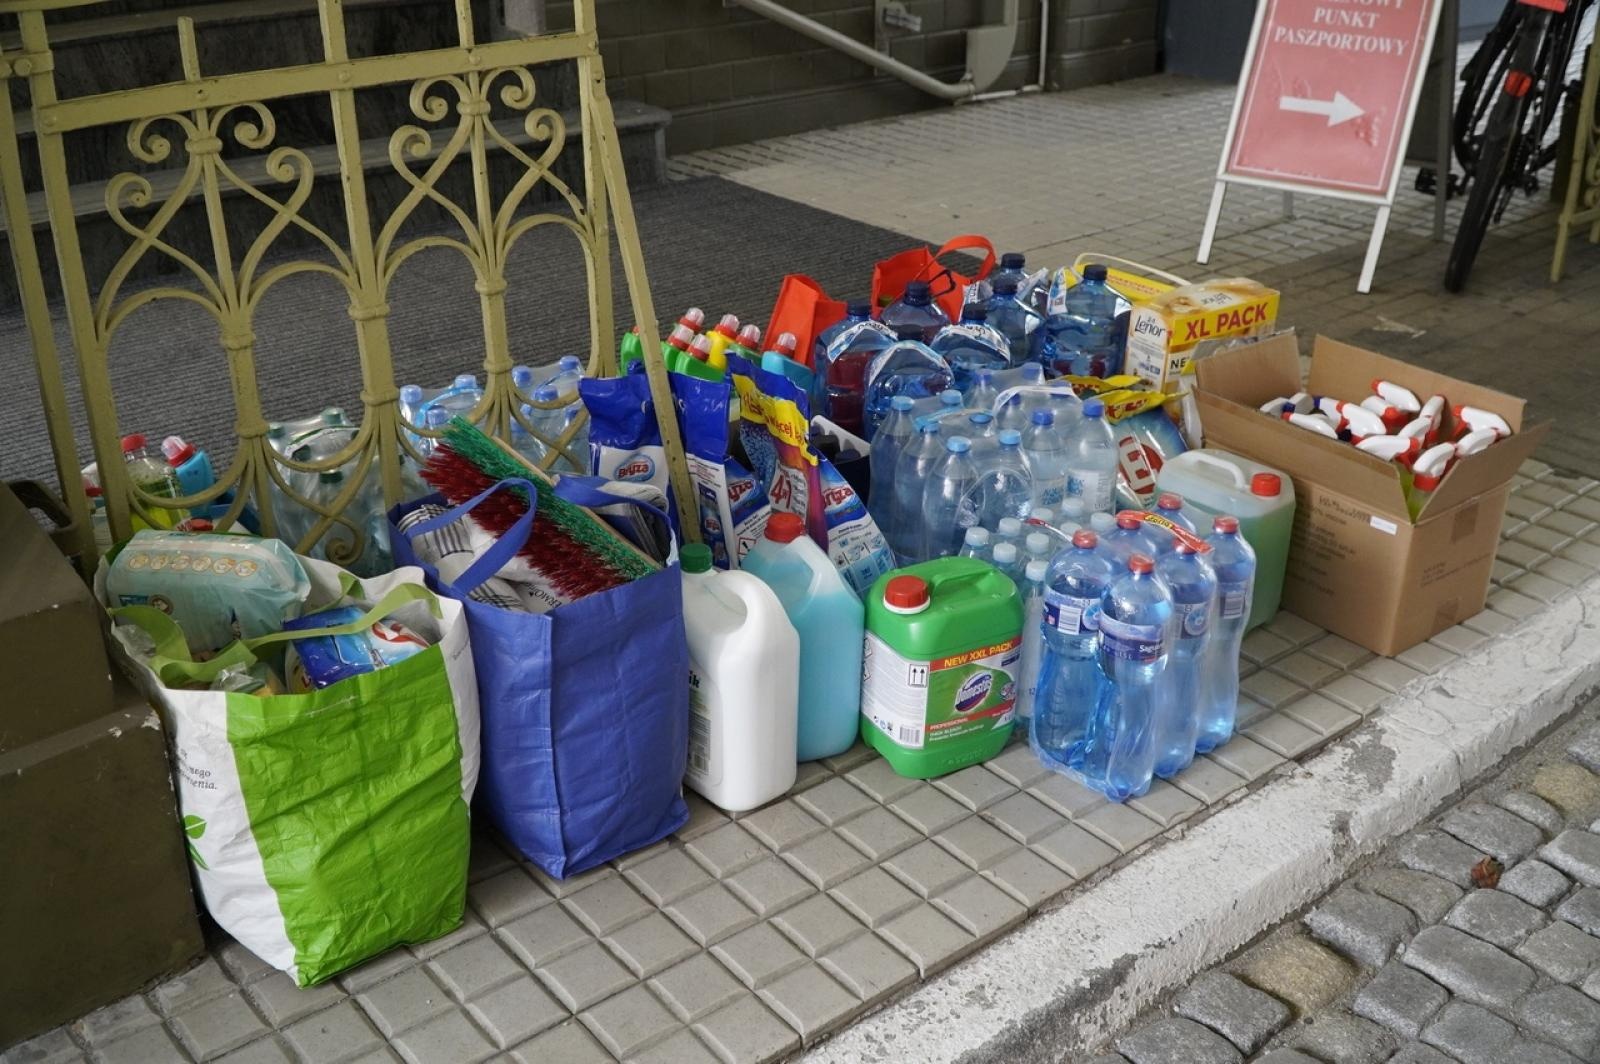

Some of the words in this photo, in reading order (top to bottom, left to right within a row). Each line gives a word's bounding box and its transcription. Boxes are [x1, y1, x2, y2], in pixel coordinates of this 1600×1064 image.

[1313, 6, 1380, 29] PUNKT
[1274, 26, 1409, 56] PASZPORTOWY
[1134, 314, 1166, 337] Lenor
[1184, 318, 1211, 341] XL
[1216, 302, 1267, 333] PACK
[617, 462, 651, 480] Bryza
[944, 655, 968, 668] NEW
[969, 649, 988, 661] XXL
[988, 642, 1014, 655] PACK
